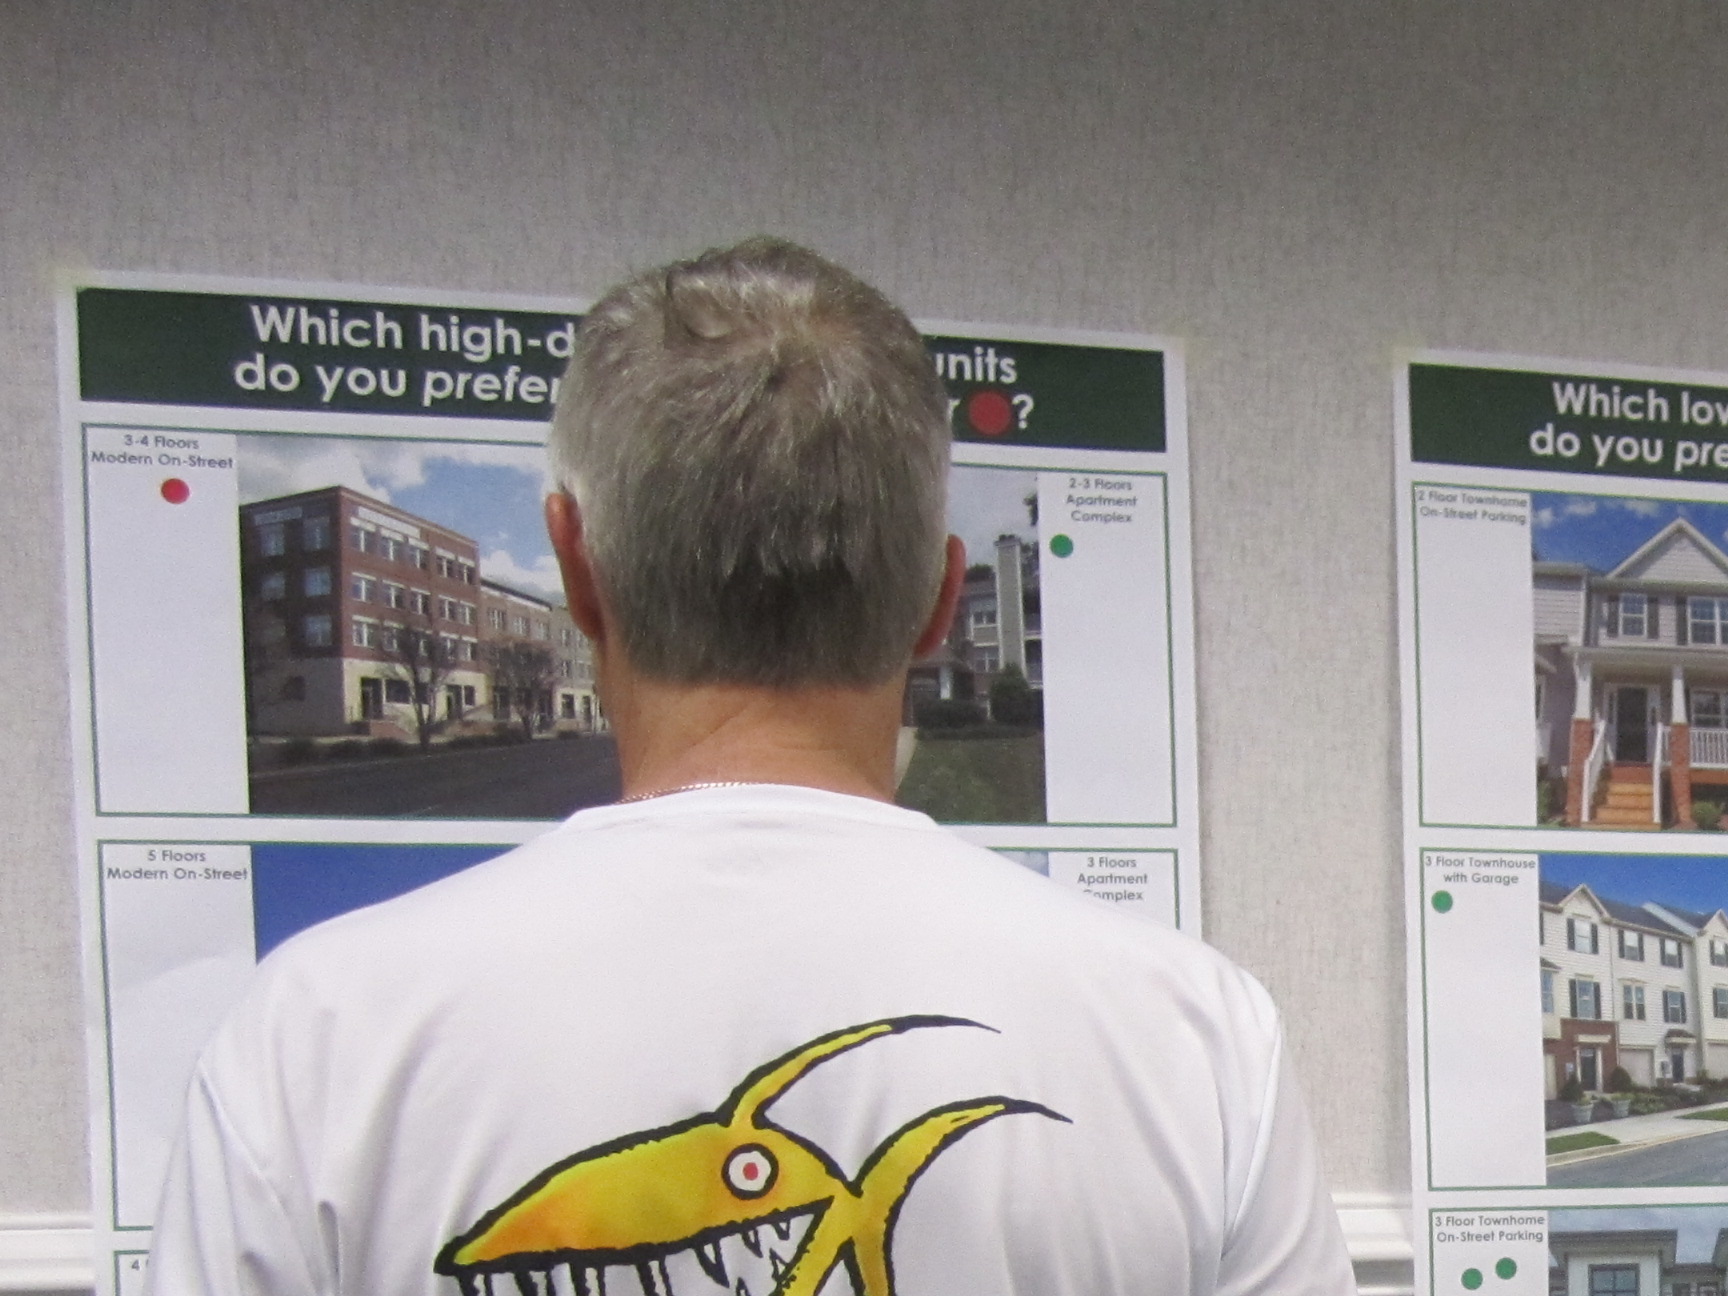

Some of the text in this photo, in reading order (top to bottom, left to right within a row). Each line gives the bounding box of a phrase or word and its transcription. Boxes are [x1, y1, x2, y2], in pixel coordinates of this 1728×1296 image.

[250, 304, 402, 350] Which
[420, 312, 576, 362] high-d
[233, 353, 300, 393] do
[315, 366, 407, 402] you
[423, 365, 562, 407] prefer
[1552, 381, 1669, 422] Which
[123, 434, 199, 449] 3-4 Floors
[1530, 423, 1581, 457] do
[1593, 434, 1664, 467] you
[91, 451, 233, 469] Modern On-Street
[1069, 477, 1132, 491] 2-3 Floors
[1066, 494, 1138, 508] Apartment
[1071, 510, 1132, 524] Complex
[147, 849, 206, 862] 5 Floors
[1087, 856, 1137, 868] 3 Floors
[1436, 856, 1465, 867] Floor
[1469, 857, 1536, 869] Townhouse
[106, 867, 248, 880] Modern On-Street
[1077, 873, 1148, 886] Apartment
[1443, 872, 1519, 886] with Garage
[1083, 889, 1144, 902] omplex
[1435, 1215, 1545, 1227] 3 Floor Townhome
[1437, 1230, 1543, 1243] On-Street Parking
